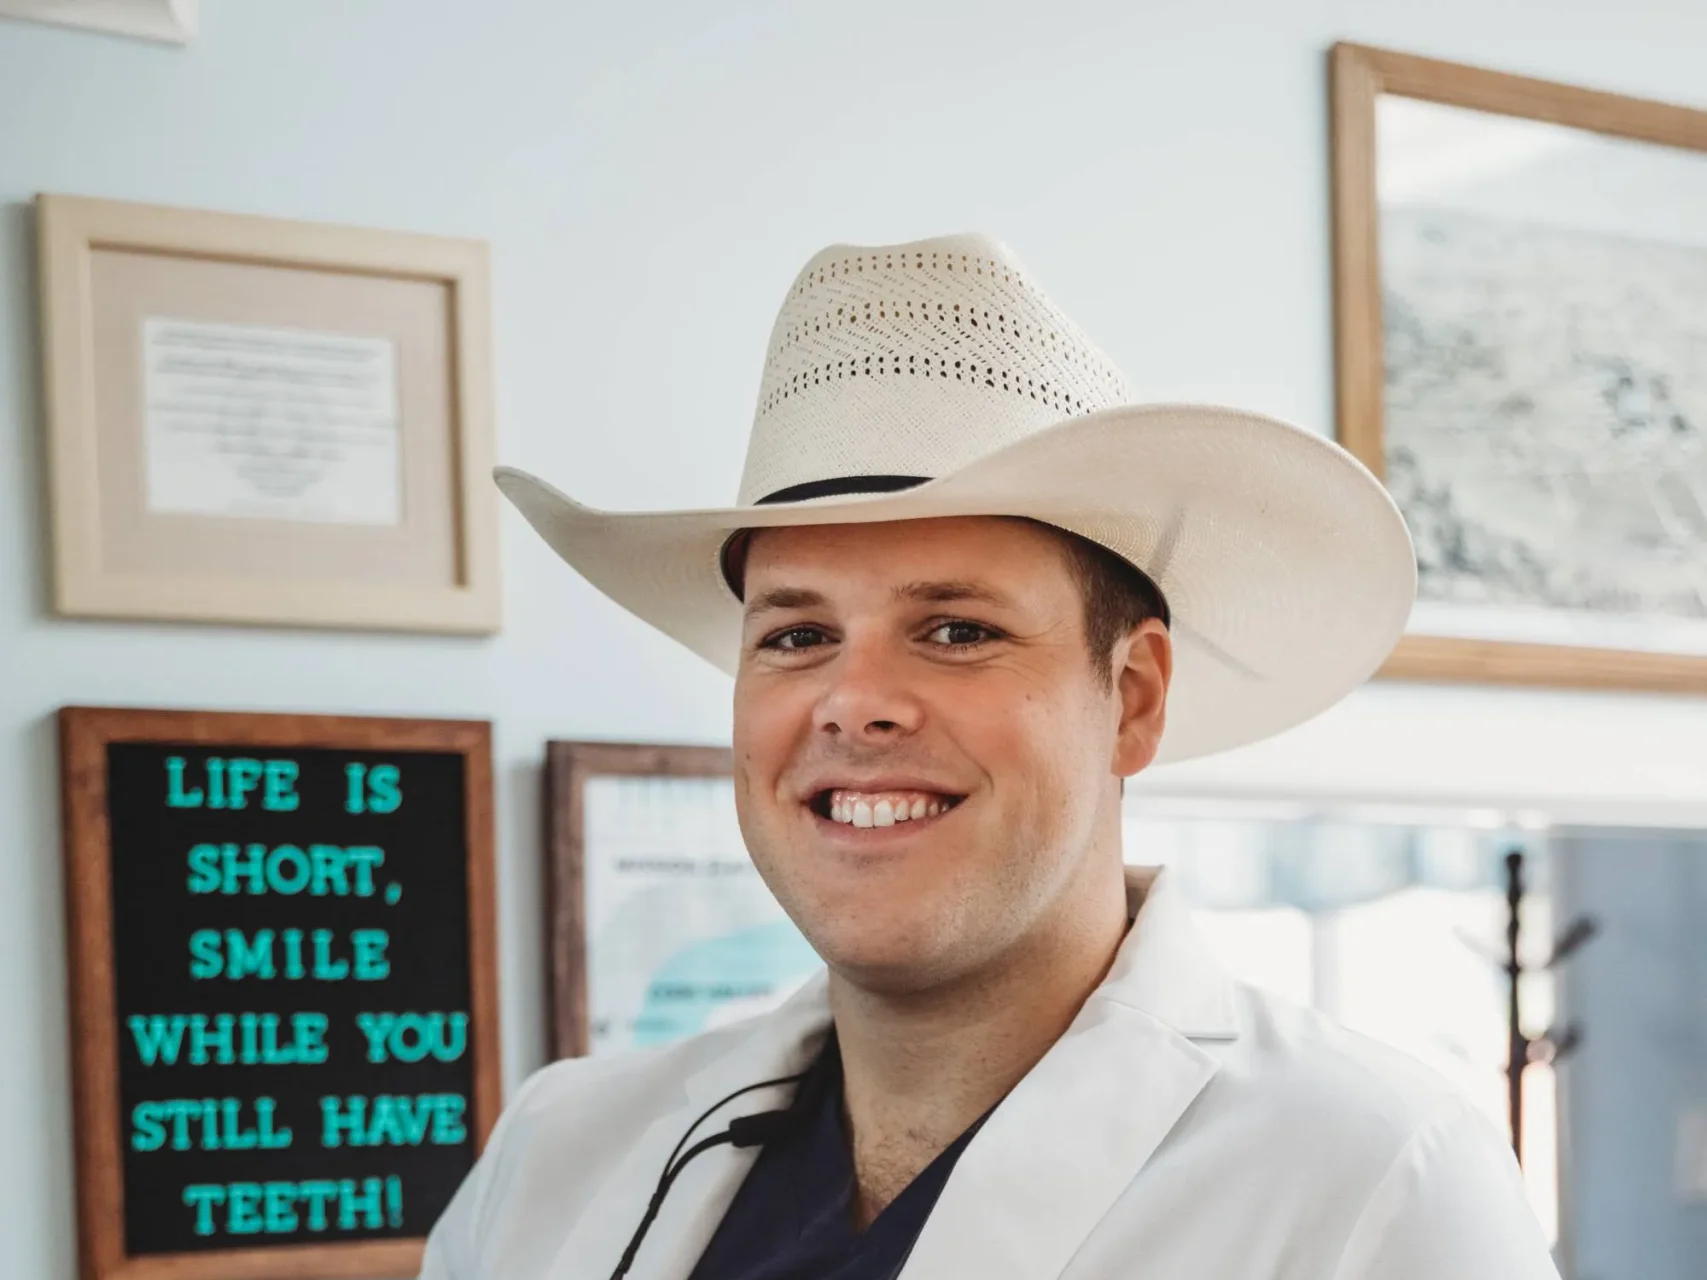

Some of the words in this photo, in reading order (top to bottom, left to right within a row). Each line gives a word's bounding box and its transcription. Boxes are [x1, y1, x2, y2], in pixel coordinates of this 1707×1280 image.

[166, 757, 300, 811] LIFE
[345, 763, 402, 813] IS
[187, 843, 402, 905] SHORT,
[189, 928, 390, 980] SMILE
[127, 1013, 329, 1066] WHILE
[356, 1012, 469, 1063] YOU
[131, 1097, 293, 1151] STILL
[320, 1093, 467, 1147] HAVE
[183, 1175, 403, 1234] TEETH!
